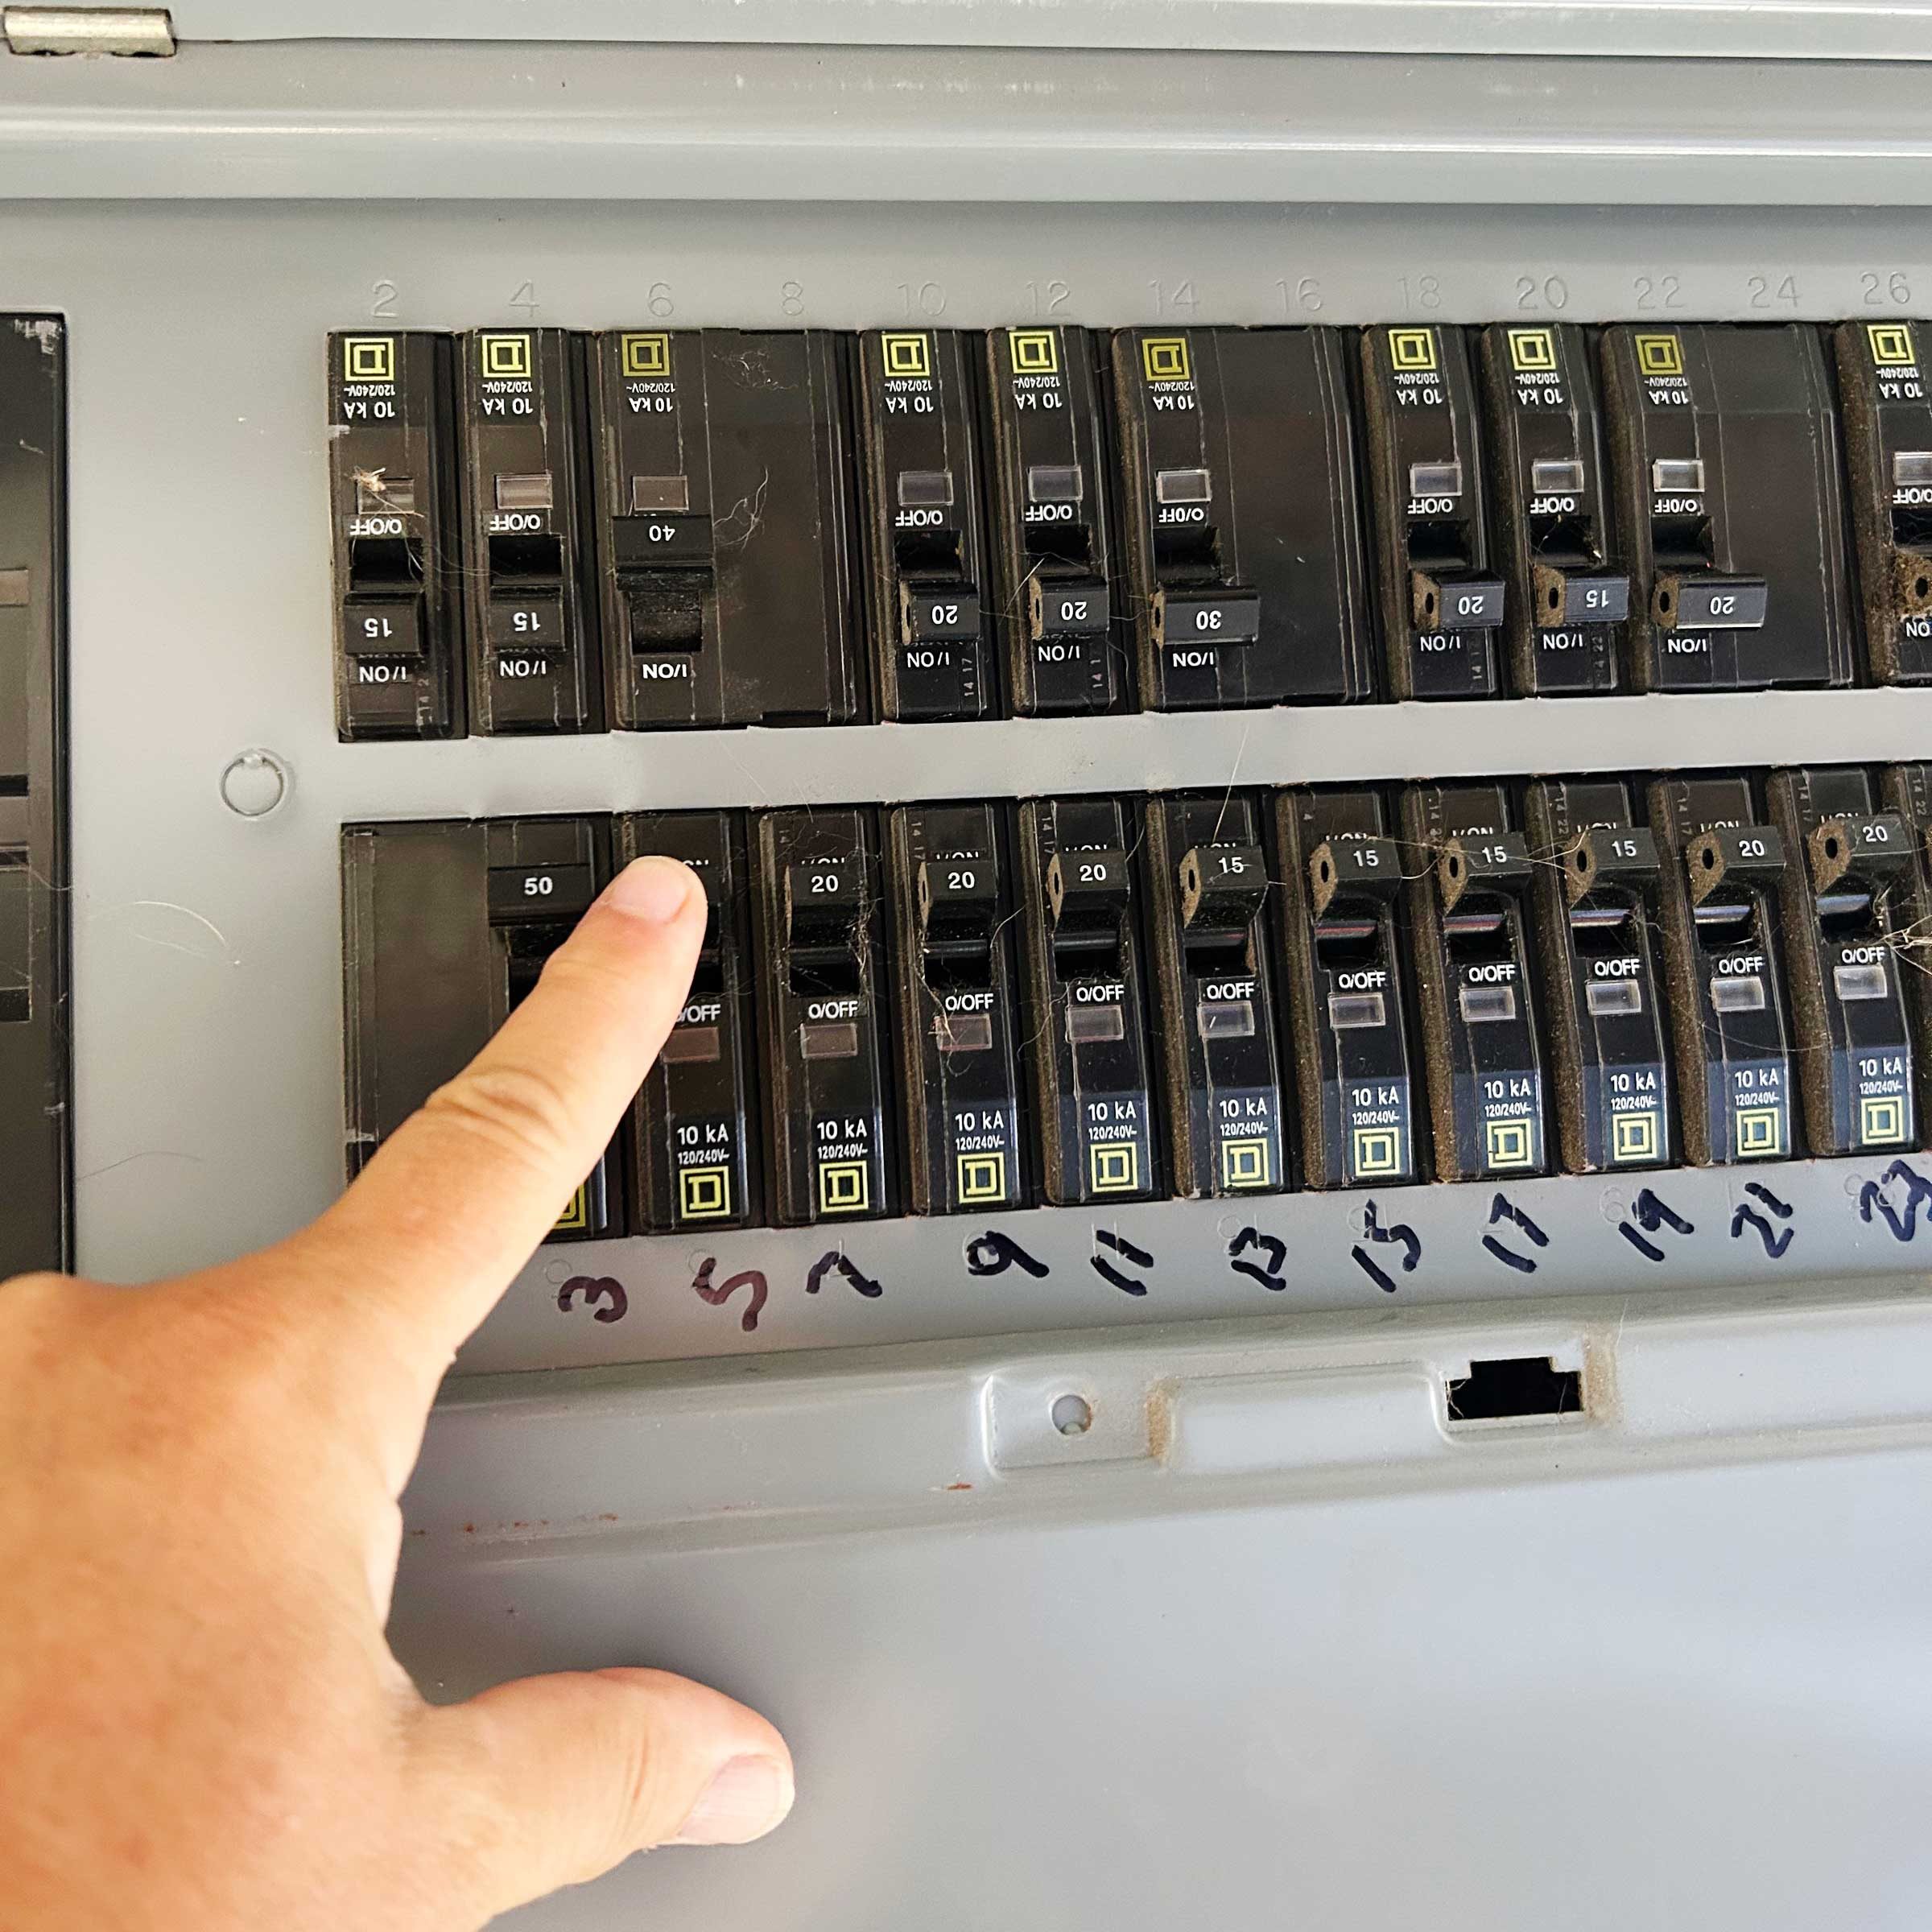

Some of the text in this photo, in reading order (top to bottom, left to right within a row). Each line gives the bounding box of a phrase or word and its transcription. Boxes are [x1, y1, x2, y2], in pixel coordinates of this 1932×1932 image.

[372, 279, 399, 318] 2
[509, 279, 540, 318] 4
[1025, 281, 1071, 316] 12
[1148, 279, 1200, 316] 14
[1276, 276, 1322, 315] 16
[1397, 276, 1441, 310] 18
[1516, 276, 1567, 310] 20
[1633, 275, 1686, 308] 22
[1747, 275, 1801, 308] 24
[1860, 272, 1911, 305] 26
[648, 283, 674, 316] 6
[782, 282, 804, 316] 8
[896, 282, 947, 316] 10
[1396, 389, 1443, 405] 10 kA
[1517, 389, 1564, 406] 10 kA
[1649, 390, 1689, 405] 10 kA
[1879, 383, 1923, 399] 10 kA
[345, 402, 395, 419] 10 kA
[483, 398, 533, 415] 10 kA
[630, 398, 673, 412] 10 kA
[886, 397, 934, 414] 10 kA
[1015, 393, 1063, 410] 10 kA
[1153, 395, 1195, 411] 10 kA
[649, 525, 675, 542] 40
[1458, 597, 1484, 615] 20
[1586, 590, 1610, 608] 15
[1710, 597, 1735, 614] 20
[513, 612, 541, 631] 15
[931, 605, 959, 625] 20
[1061, 602, 1088, 621] 20
[1195, 610, 1222, 630] 30
[364, 618, 393, 638] 15
[1905, 621, 1932, 638] ON
[1862, 825, 1889, 843] 20
[1353, 850, 1379, 867] 15
[1482, 847, 1507, 863] 15
[1612, 840, 1637, 857] 15
[1739, 840, 1765, 857] 20
[1080, 864, 1107, 881] 20
[1218, 857, 1244, 873] 15
[524, 877, 553, 895] 50
[811, 875, 839, 893] 20
[948, 872, 975, 889] 20
[1859, 1057, 1902, 1077] 10 kA
[1610, 1071, 1656, 1092] 10 kA
[1735, 1067, 1778, 1088] 10 kA
[1352, 1087, 1399, 1106] 10 kA
[1484, 1079, 1531, 1099] 10 kA
[1088, 1100, 1137, 1121] 10 kA
[1220, 1097, 1267, 1117] 10 kA
[817, 1118, 867, 1140] 10 kA
[955, 1110, 1004, 1133] 10 kA
[677, 1123, 729, 1145] 10 kA
[1619, 1189, 1694, 1261] 19
[1732, 1183, 1794, 1258] 21
[1482, 1193, 1549, 1274] 17
[966, 1231, 1050, 1278] 9
[1352, 1199, 1421, 1293] 15
[1091, 1230, 1154, 1296] 11
[1229, 1227, 1286, 1290] 13
[558, 1275, 627, 1323] 3
[691, 1257, 768, 1331] 5
